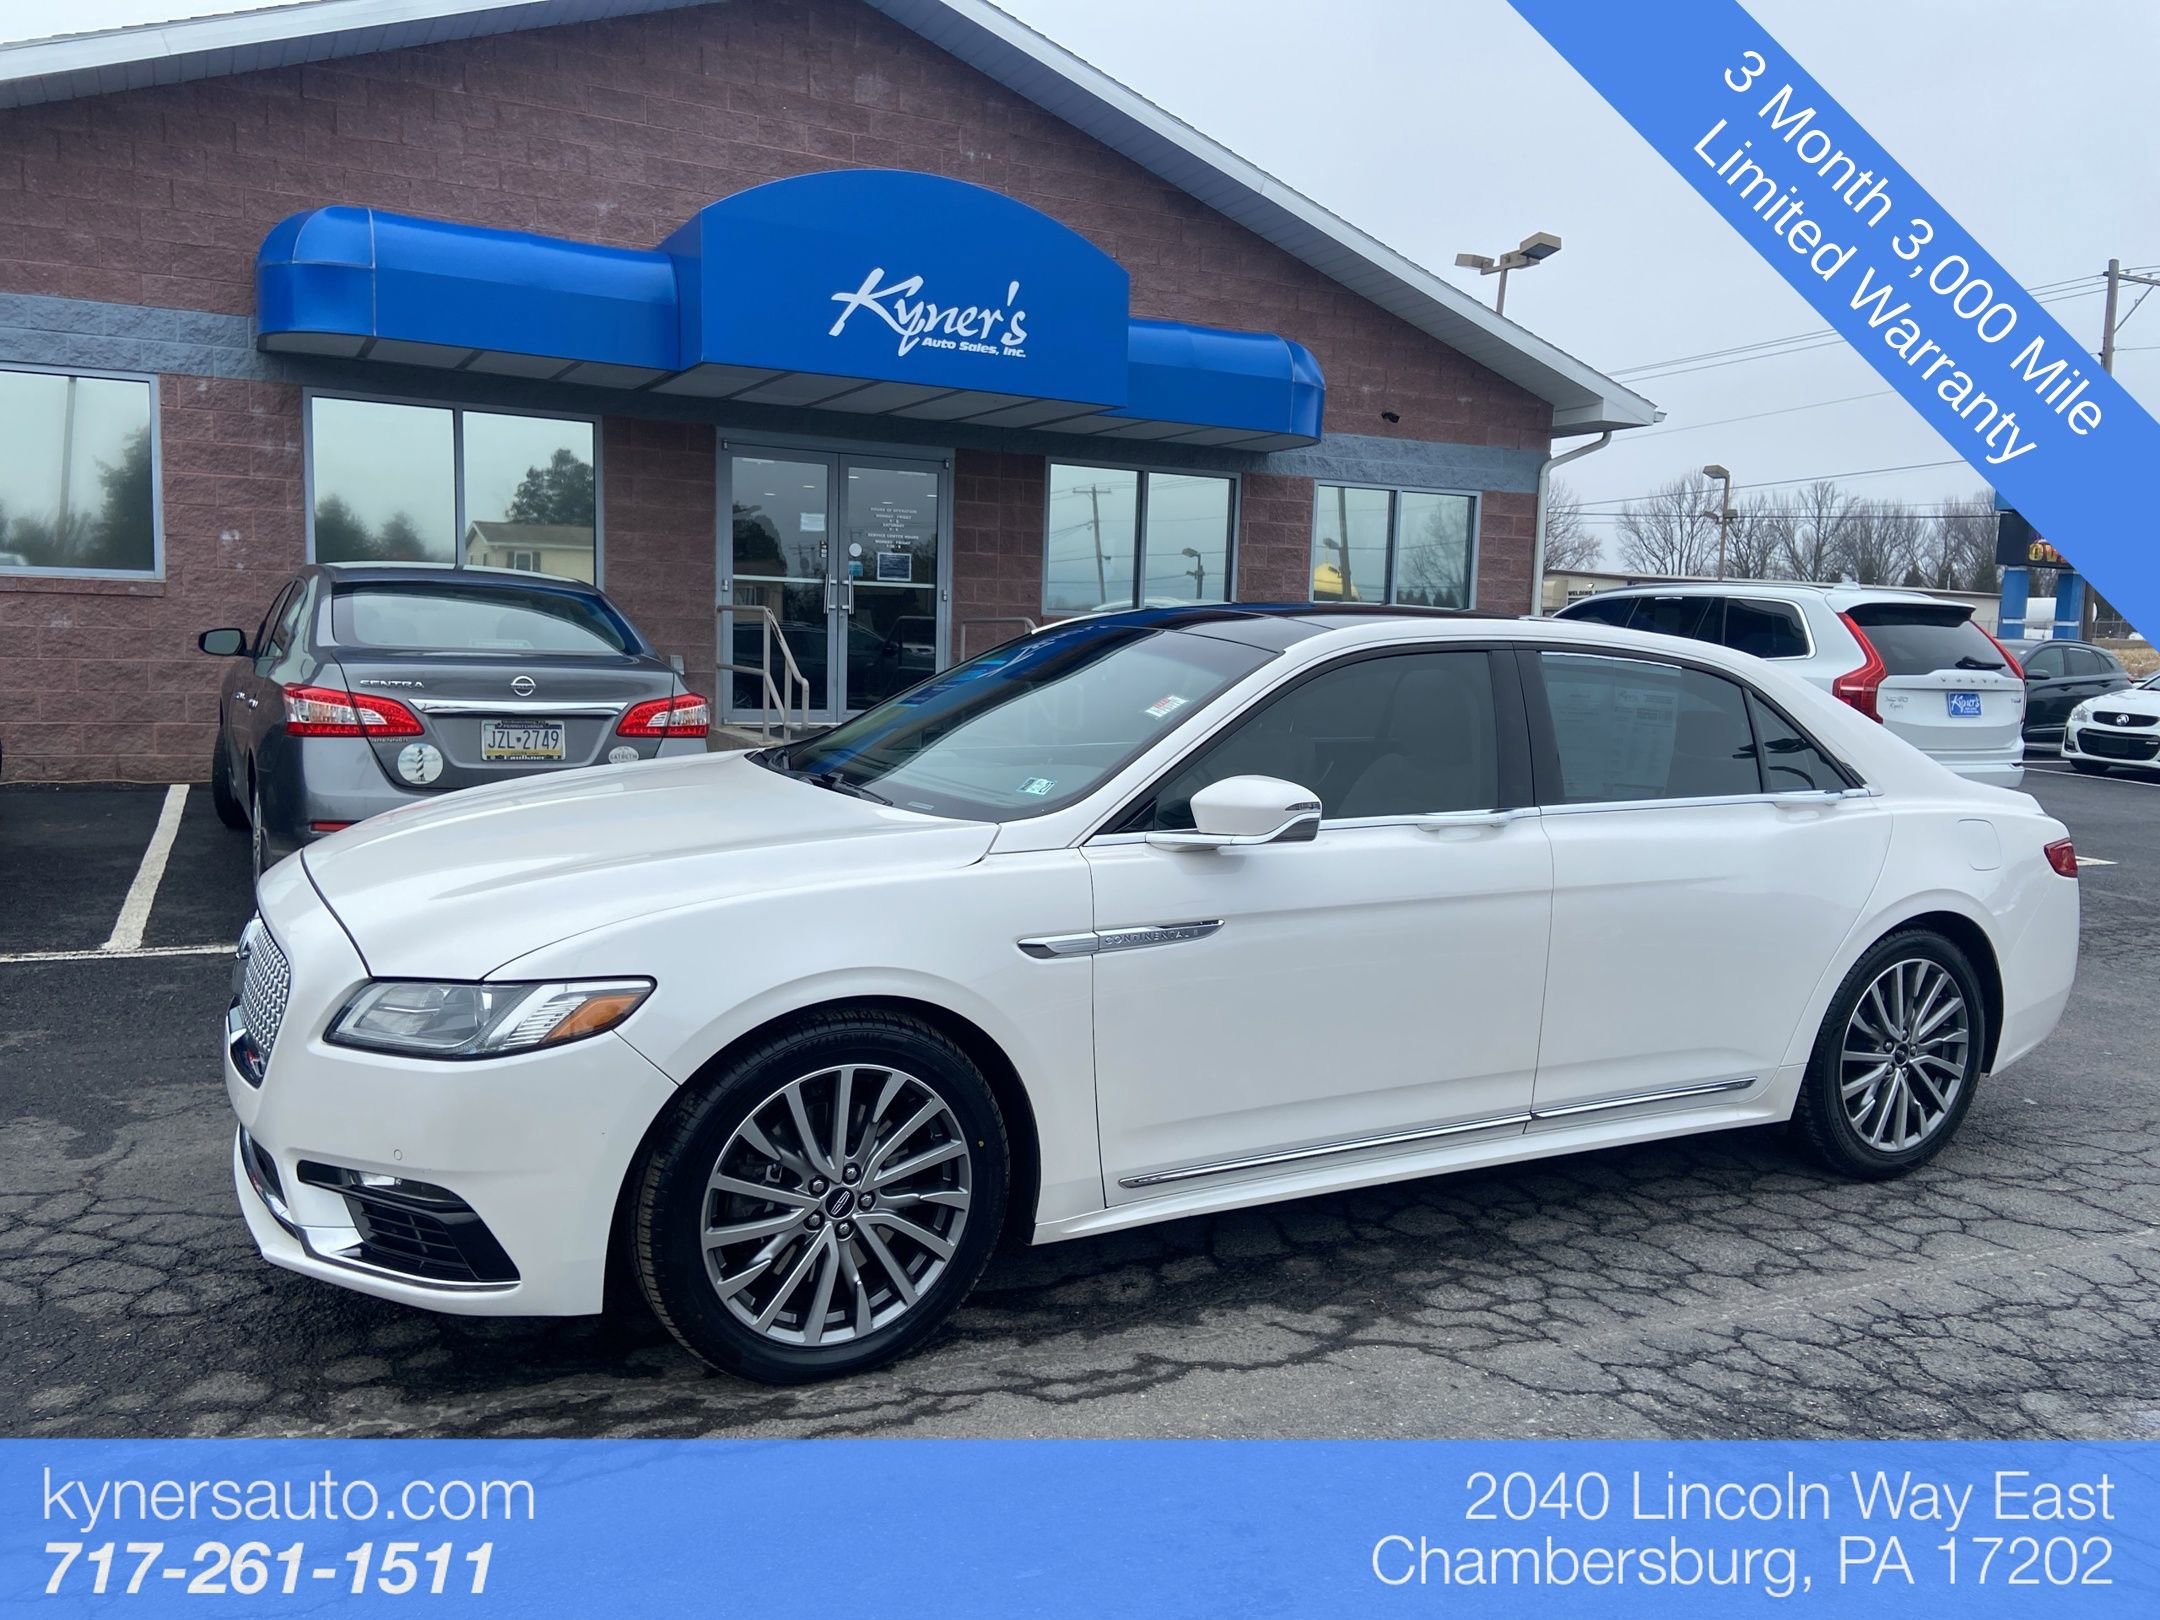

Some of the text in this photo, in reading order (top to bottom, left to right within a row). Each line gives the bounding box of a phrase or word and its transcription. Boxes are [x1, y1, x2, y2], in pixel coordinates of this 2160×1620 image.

[828, 267, 1028, 357] Kyner's
[921, 337, 1027, 358] Auto Sales, Inc.
[359, 679, 425, 689] SENTRA
[1105, 932, 1190, 945] CONTINENTAL
